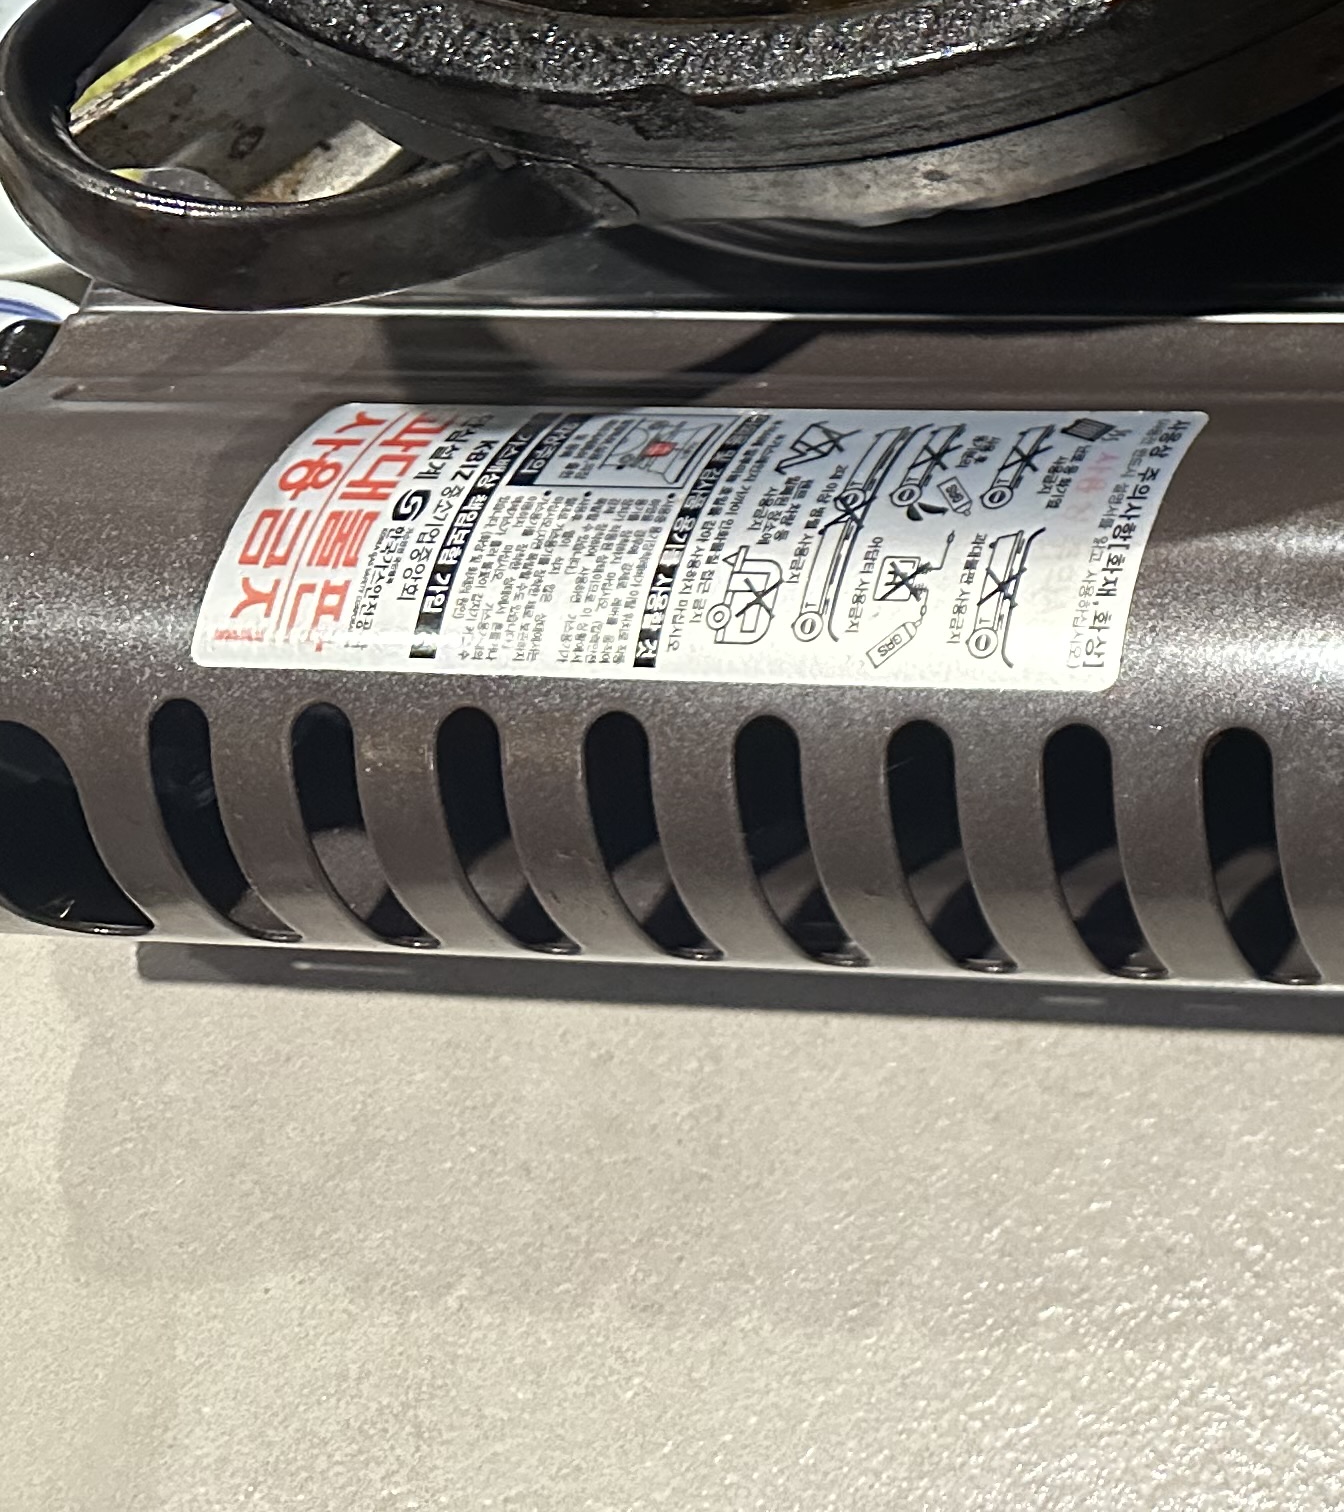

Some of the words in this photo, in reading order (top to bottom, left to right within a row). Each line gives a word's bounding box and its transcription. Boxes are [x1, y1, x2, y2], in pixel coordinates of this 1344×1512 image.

[517, 422, 581, 473] 화상주의
[709, 449, 738, 461] 및
[1146, 419, 1193, 458] 사용상
[473, 434, 536, 488] 가스배상
[828, 463, 849, 479] 2대
[1035, 455, 1070, 495] 사용금지
[681, 467, 724, 509] 검사품
[706, 486, 735, 516] 호일을
[723, 485, 752, 515] 가까이
[772, 475, 802, 506] 밀폐된
[814, 482, 839, 503] 이상
[1096, 482, 1131, 529] 설명서를
[209, 413, 390, 642] 사용금지
[746, 487, 780, 531] 사용금지
[755, 510, 783, 545] 장소에
[778, 502, 802, 526] 차량
[803, 507, 826, 529] 병렬
[277, 412, 465, 653] 과대불판
[392, 484, 468, 601] 중소기업중앙회
[435, 493, 490, 565] 책임보험
[535, 523, 565, 565] 가스용기를
[656, 515, 698, 566] 용기를
[694, 520, 718, 542] 감아
[703, 518, 735, 565] 인화물질
[771, 529, 791, 542] 등
[506, 543, 529, 570] 장착한
[547, 556, 565, 574] 식지
[784, 532, 815, 583] 사용금지
[858, 535, 885, 574] 어답터
[958, 532, 988, 585] 과대불판
[1086, 535, 1109, 563] 읽고
[525, 569, 547, 596] 장착한
[568, 566, 591, 603] 사용하면
[676, 544, 708, 595] 사용하지
[694, 569, 716, 594] 접근
[420, 571, 454, 613] 가입
[464, 593, 484, 621] 갑자기
[493, 576, 517, 615] 상태에서
[511, 582, 528, 601] 수도
[637, 572, 676, 631] 사용할
[687, 597, 708, 623] 금지
[843, 577, 873, 633] 사용금지
[944, 587, 973, 644] 사용금지
[634, 638, 661, 658] 것
